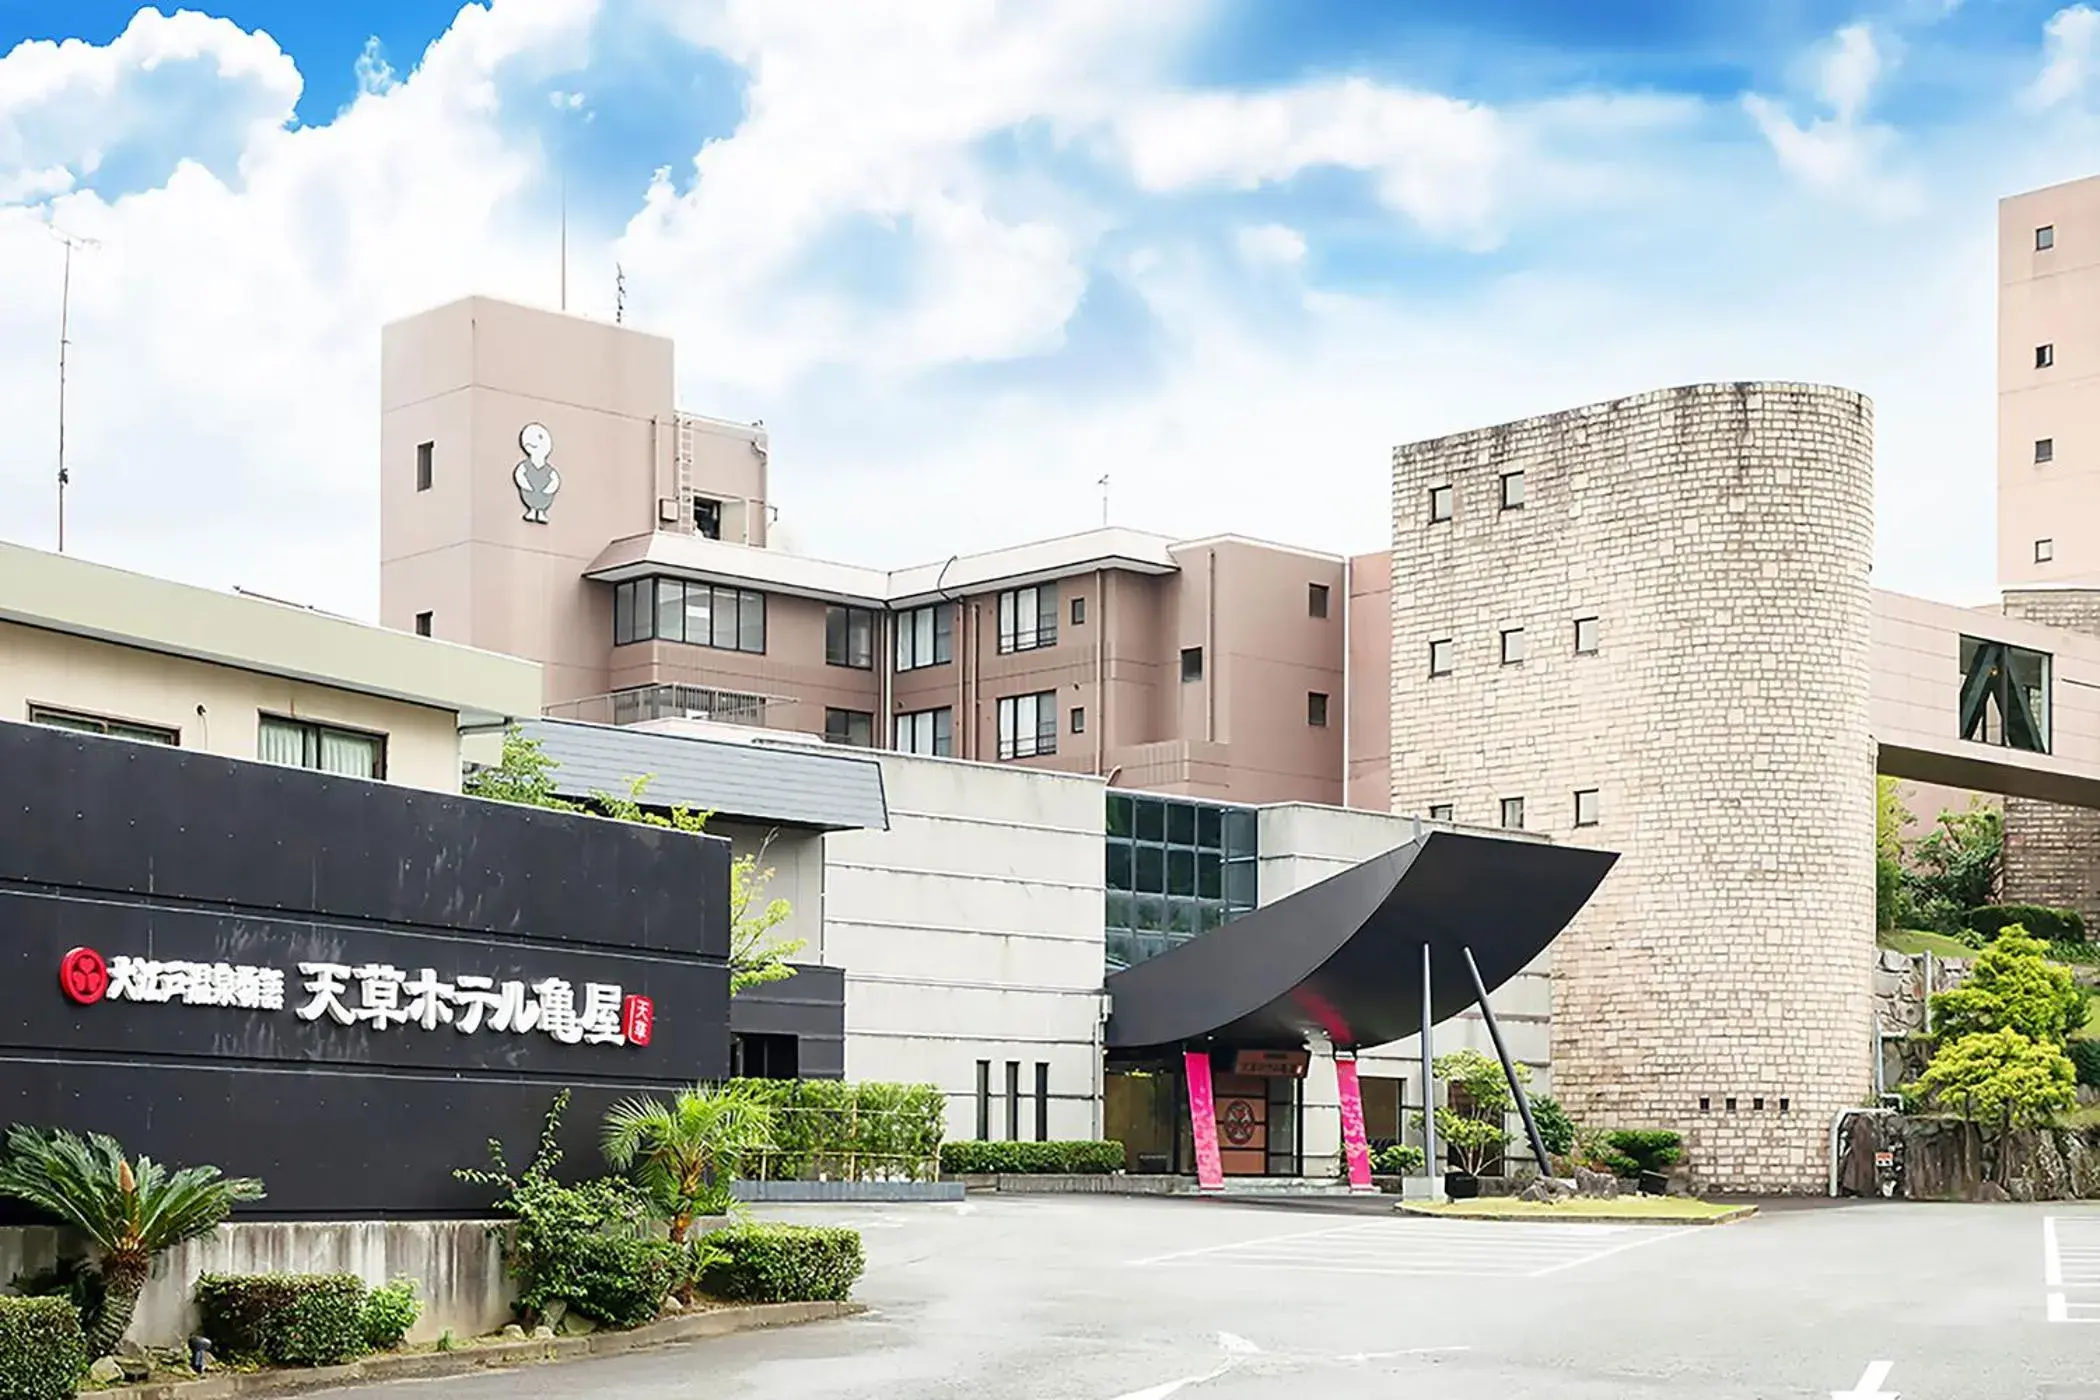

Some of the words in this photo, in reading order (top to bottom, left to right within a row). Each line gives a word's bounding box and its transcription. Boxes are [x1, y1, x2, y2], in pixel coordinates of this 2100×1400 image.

[295, 961, 626, 1046] 天草ホテル亀屋
